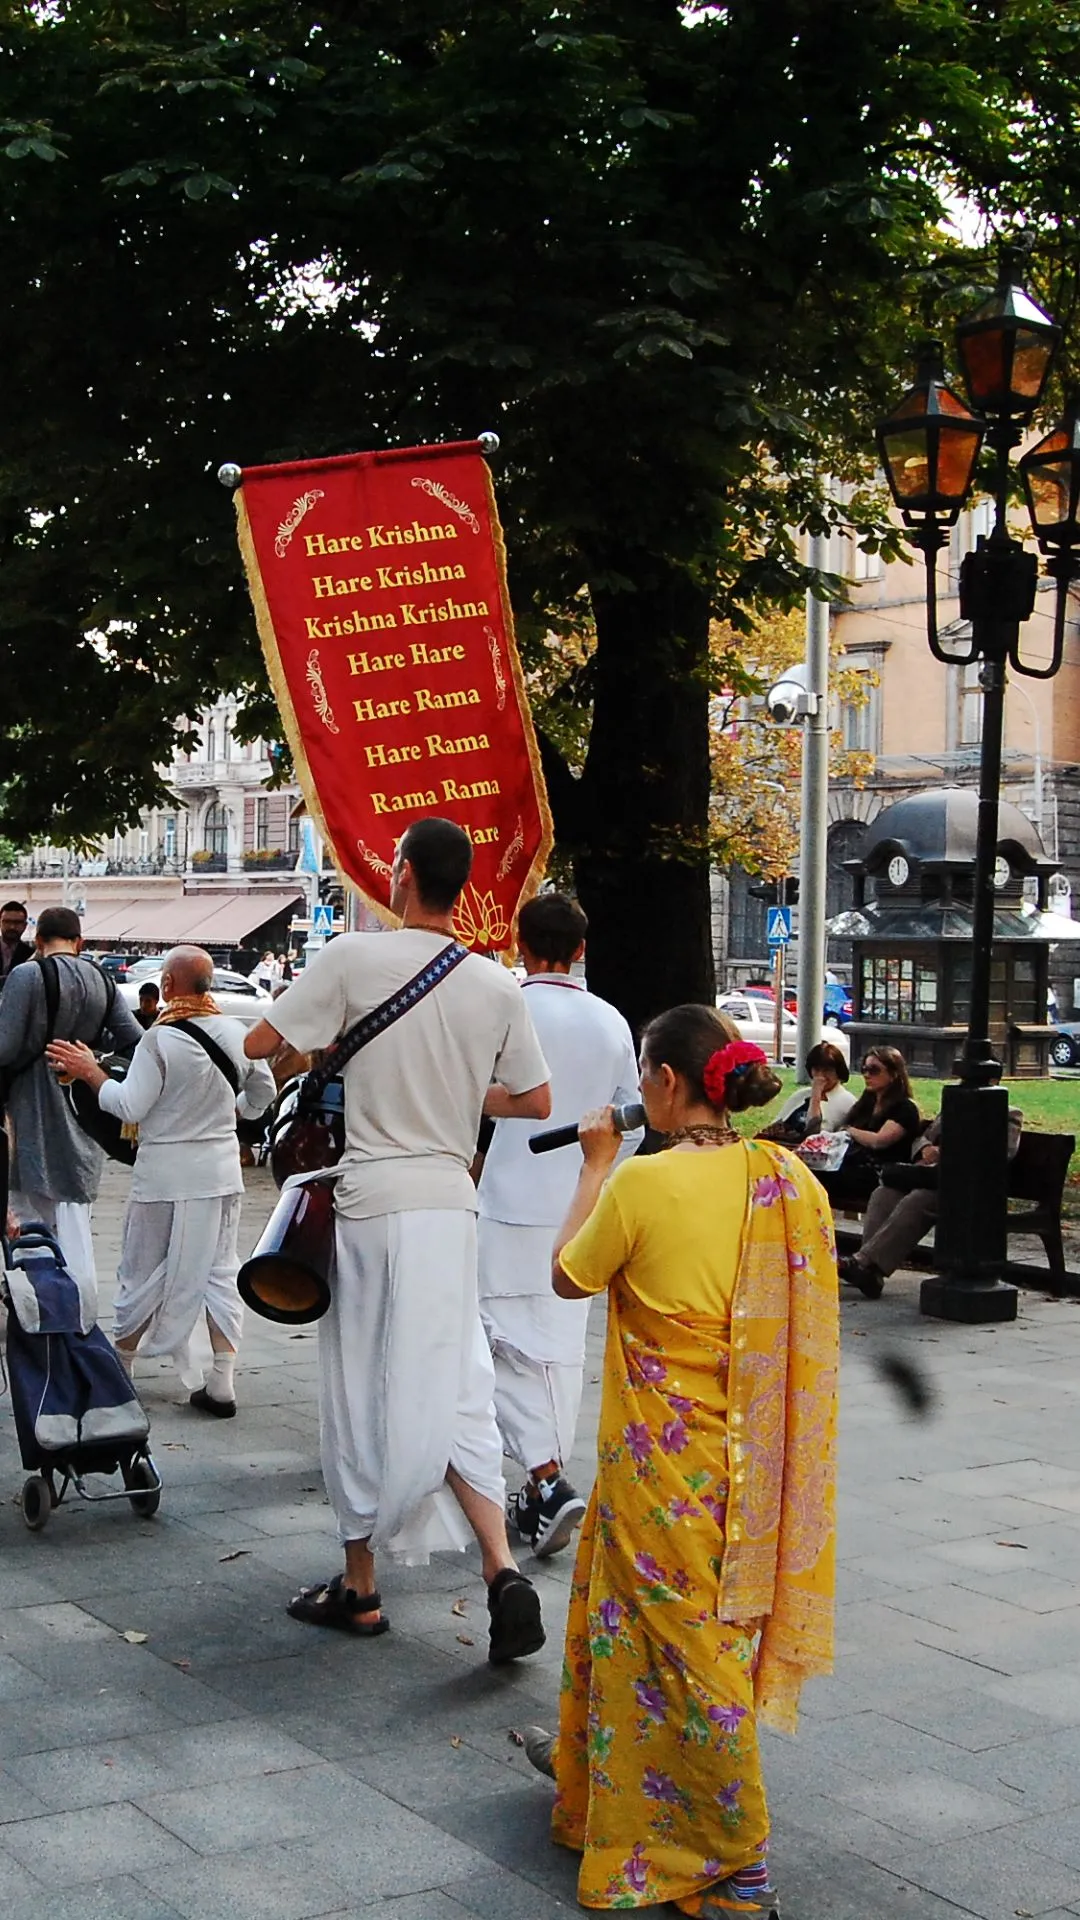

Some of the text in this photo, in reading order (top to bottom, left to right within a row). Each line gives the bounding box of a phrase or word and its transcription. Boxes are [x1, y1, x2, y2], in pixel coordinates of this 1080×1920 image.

[304, 520, 458, 556] Hare Krishna
[311, 562, 467, 598] Hare Krishna
[303, 598, 489, 638] Krishna Krishna
[346, 643, 466, 676] Hare Hare
[352, 688, 481, 721] Hare Rama
[364, 734, 490, 768] Hare Rama
[370, 779, 501, 815] Rama Rama
